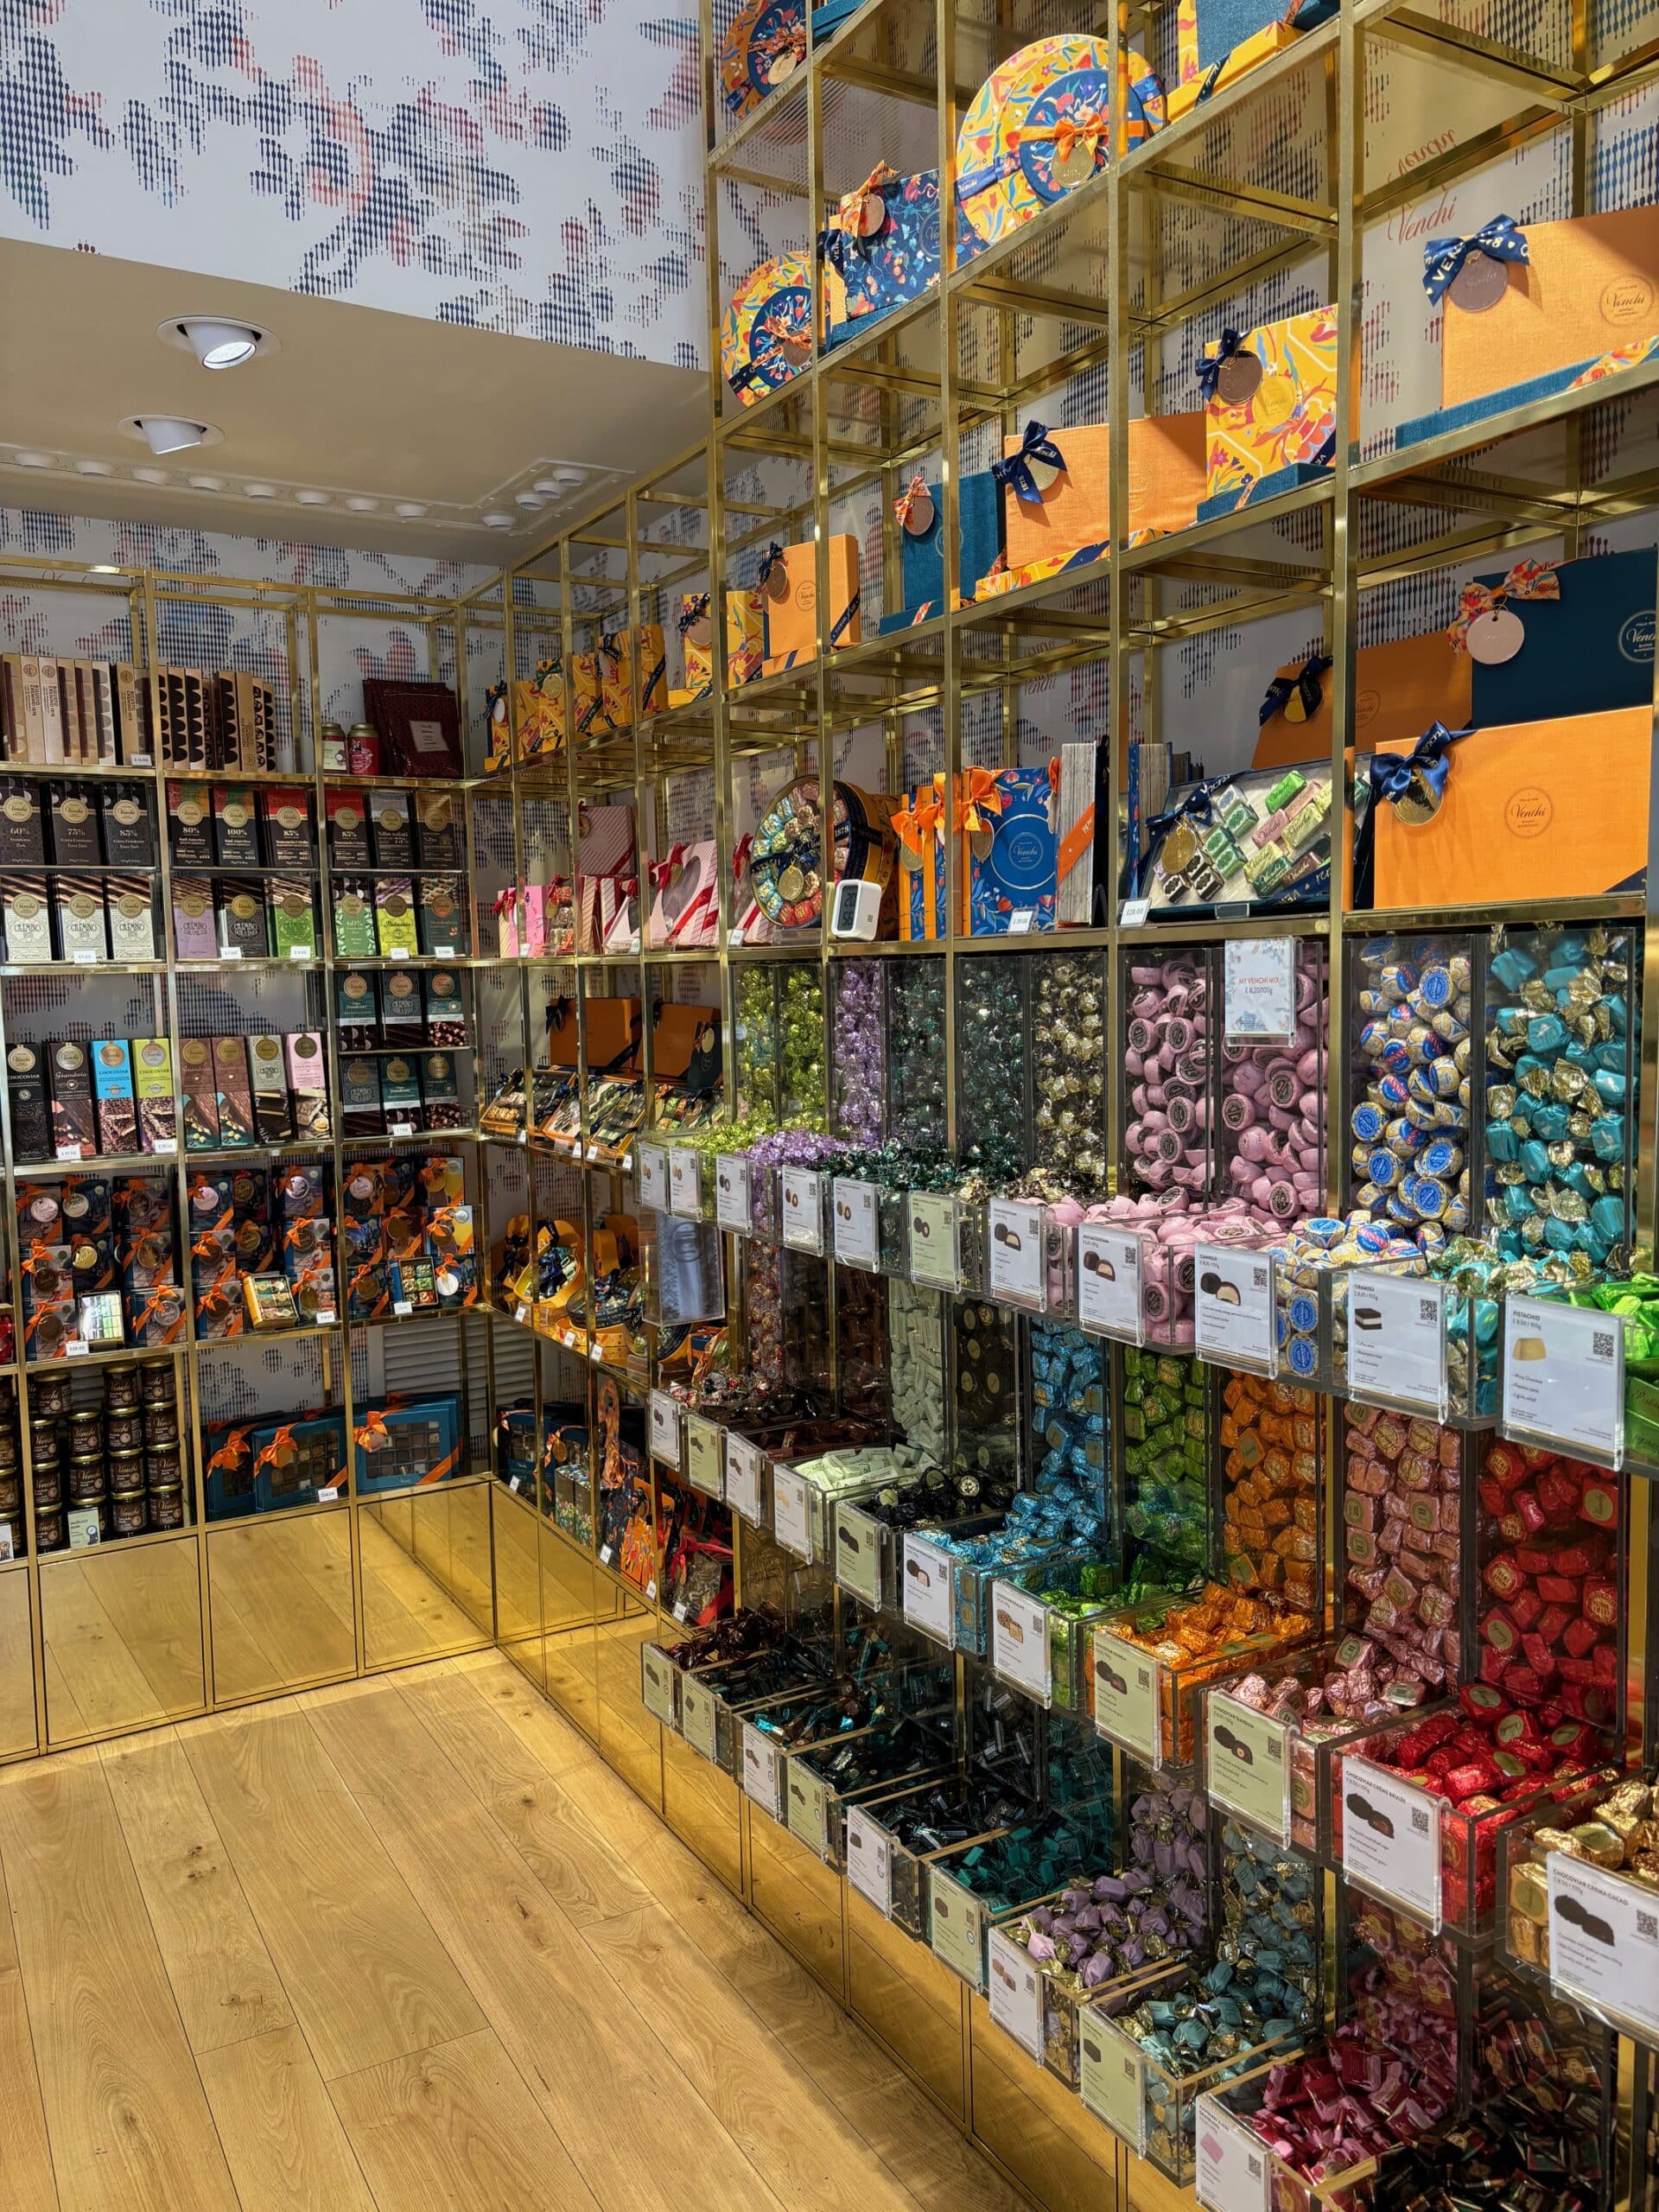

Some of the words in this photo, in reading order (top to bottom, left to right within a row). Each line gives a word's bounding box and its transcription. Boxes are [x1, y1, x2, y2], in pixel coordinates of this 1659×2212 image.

[1388, 191, 1457, 245] Venchi
[1606, 292, 1646, 308] Venchi
[1511, 804, 1547, 818] Venchi
[10, 827, 30, 836] 60%
[1013, 845, 1038, 856] Venchi
[14, 923, 41, 932] CREMINO
[71, 923, 98, 932] CREMINO
[119, 922, 145, 932] CREMINO
[1513, 1311, 1541, 1321] PISTACHIO
[1346, 1770, 1373, 1787] CHOCOVIAR
[1554, 1869, 1586, 1887] CHOCOVIAR
[1586, 1884, 1606, 1897] CREMA
[1607, 1892, 1629, 1906] CACAO
